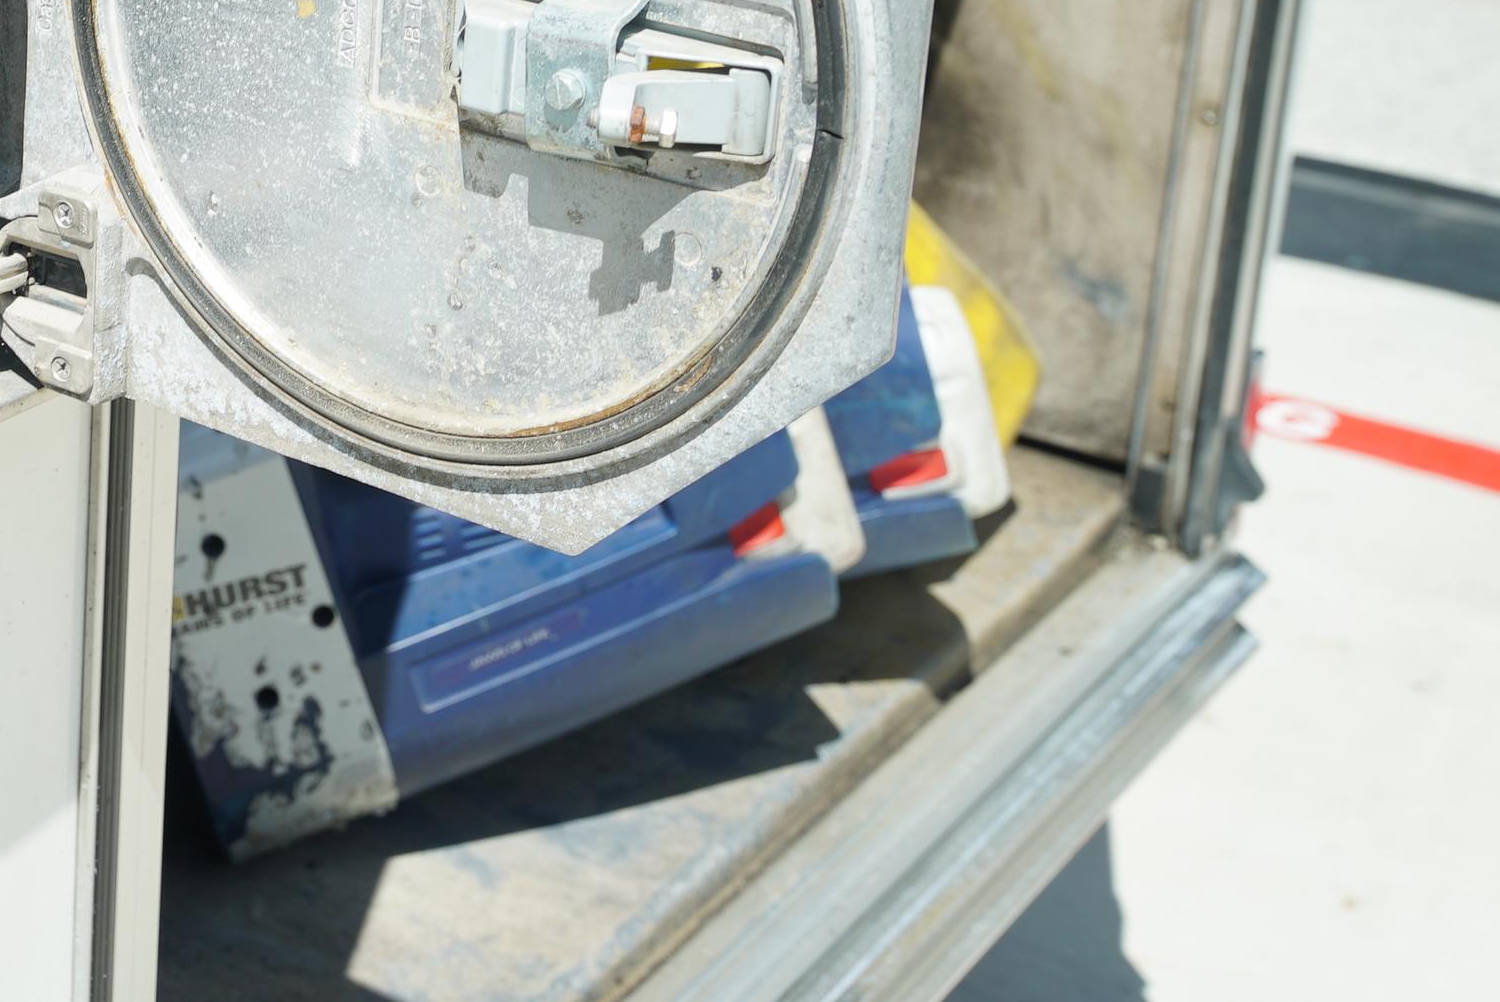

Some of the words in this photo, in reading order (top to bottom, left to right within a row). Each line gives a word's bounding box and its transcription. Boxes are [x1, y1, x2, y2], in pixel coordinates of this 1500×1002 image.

[183, 563, 307, 616] HURST
[172, 612, 224, 637] AWS
[231, 604, 256, 622] OF
[263, 593, 307, 614] LIFE
